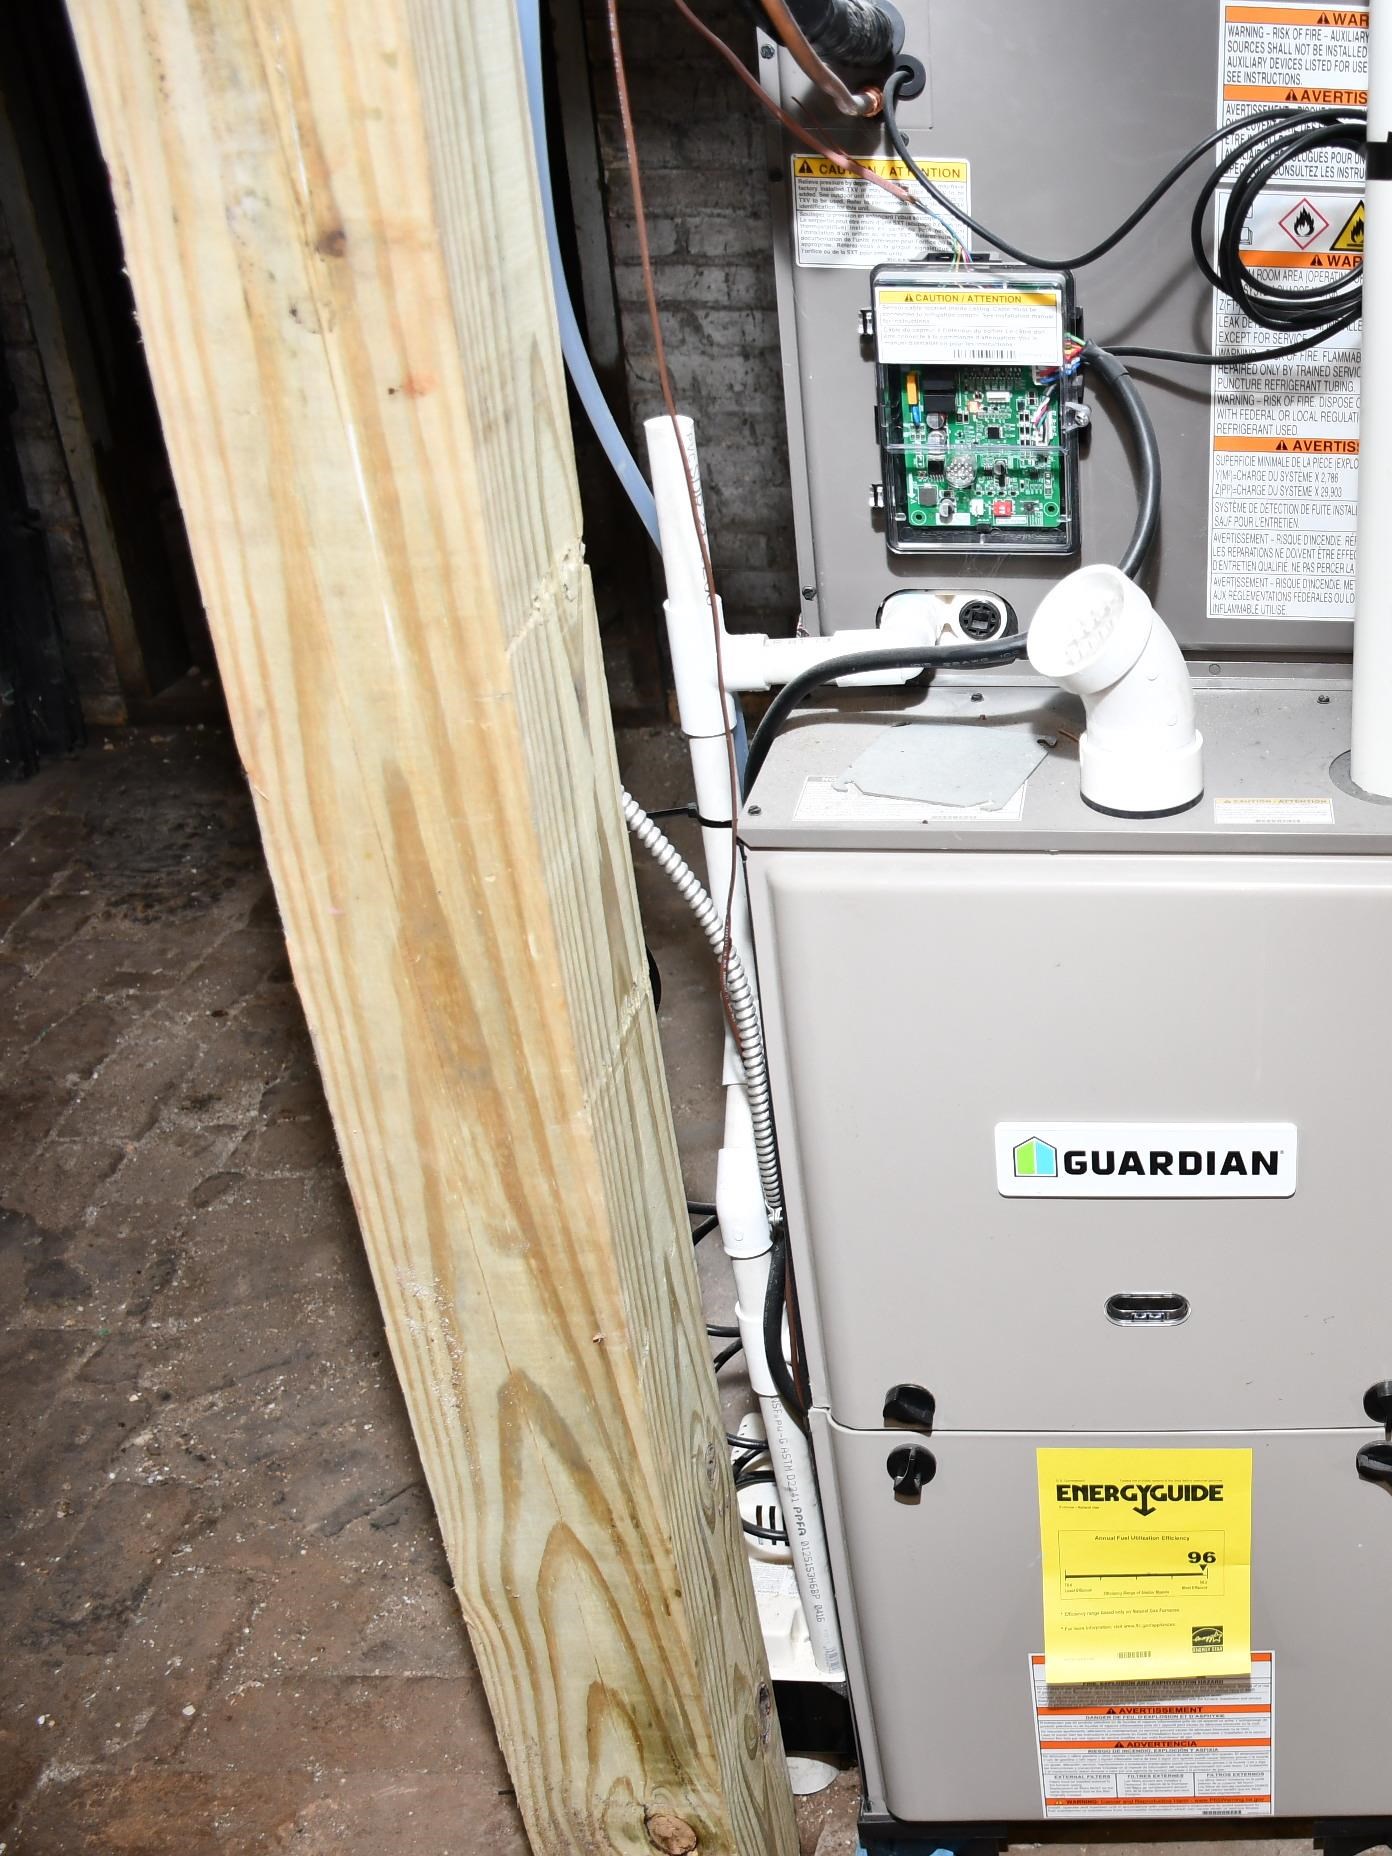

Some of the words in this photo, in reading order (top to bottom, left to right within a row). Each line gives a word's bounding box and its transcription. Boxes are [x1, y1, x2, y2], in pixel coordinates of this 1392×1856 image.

[1228, 26, 1264, 38] WARNING
[1273, 27, 1290, 39] RISK
[1293, 28, 1303, 40] OF
[1305, 29, 1322, 41] FIRE
[1331, 30, 1369, 43] AUXILIARY
[1228, 41, 1264, 54] SOURCES
[1268, 42, 1292, 55] SHALL
[1295, 43, 1310, 55] NOT
[1313, 44, 1323, 56] BE
[1326, 45, 1367, 58] INSTALLED
[1228, 56, 1267, 69] AUXILIARY
[1270, 58, 1302, 70] DEVICES
[1305, 59, 1331, 71] LISTED
[1334, 60, 1350, 72] FOR
[1353, 61, 1368, 73] USE
[1227, 71, 1241, 83] SEE
[1244, 72, 1302, 85] INSTRUCTIONS.
[1301, 91, 1367, 104] AVERTIS
[1331, 152, 1352, 164] POUR
[1321, 166, 1334, 177] LES
[1282, 269, 1303, 282] AREA
[916, 294, 959, 302] CAUTION
[967, 294, 1022, 303] ATTENTION
[1219, 315, 1240, 328] LEAK
[1219, 331, 1251, 343] EXCEPT
[1254, 332, 1270, 344] FOR
[1322, 351, 1361, 362] FLAMMAB
[1218, 364, 1257, 375] REPAIRED
[1260, 365, 1280, 375] ONLY
[1283, 365, 1292, 376] BY
[1297, 365, 1329, 377] TRAINED
[1333, 366, 1361, 377] SERVIC
[1218, 378, 1261, 389] PUNCTURE
[1265, 379, 1321, 392] REFRIGERANT
[1324, 380, 1355, 392] TUBING.
[1218, 394, 1255, 405] WARNING
[1264, 395, 1281, 406] RISK
[1284, 396, 1295, 407] OF
[1320, 397, 1354, 408] DISPOSE
[1217, 409, 1238, 420] WITH
[1240, 410, 1276, 421] FEDERAL
[1278, 410, 1290, 421] OR
[1293, 411, 1318, 422] LOCAL
[1217, 423, 1273, 435] REFRIGERANT
[1292, 457, 1301, 468] DE
[1301, 504, 1310, 515] DE
[1312, 504, 1331, 515] FUITE
[1214, 532, 1269, 544] AVERTISSEMENT
[1213, 547, 1226, 557] LES
[1292, 561, 1301, 572] NE
[1303, 562, 1315, 573] PAS
[1317, 562, 1345, 573] PERCER
[1346, 564, 1354, 574] LA
[1214, 577, 1268, 587] AVERTISSEMENT
[1335, 593, 1345, 603] OU
[1064, 1150, 1278, 1176] GUARDIAN
[779, 1446, 794, 1472] ASTM
[793, 1506, 807, 1537] PPFA
[1056, 1484, 1224, 1507] ENERGYGUIDE
[1188, 1552, 1216, 1563] 96
[1127, 1740, 1197, 1748] ADVERTENCIA
